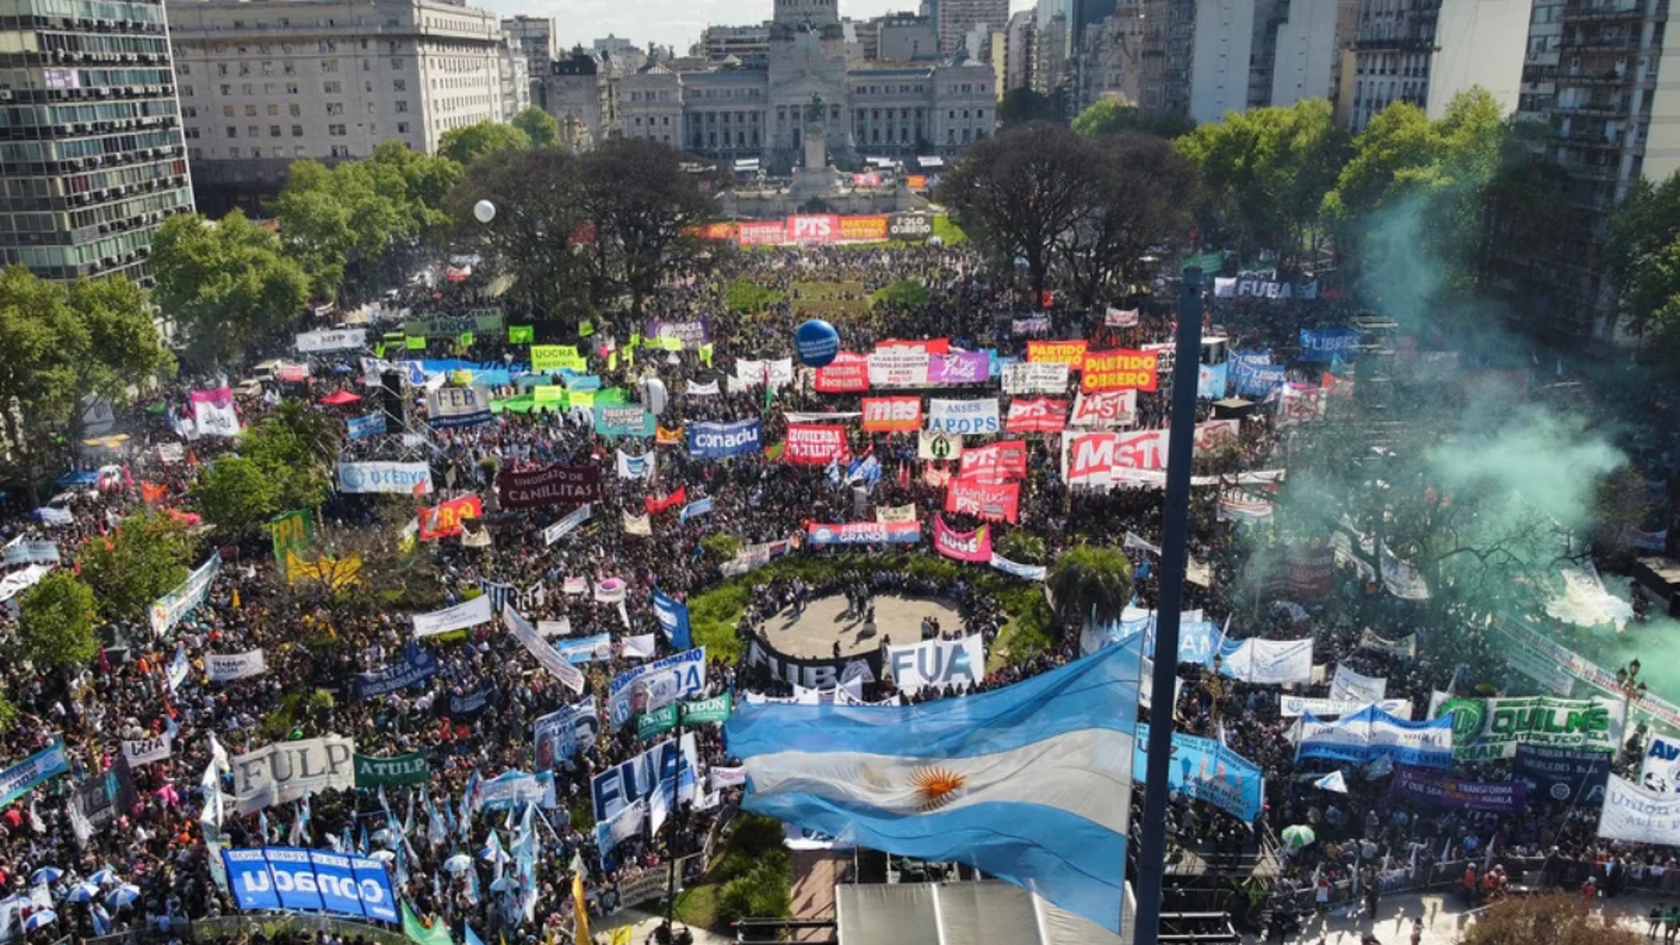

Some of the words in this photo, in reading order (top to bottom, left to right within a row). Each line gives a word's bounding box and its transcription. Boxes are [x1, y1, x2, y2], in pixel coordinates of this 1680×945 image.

[794, 218, 831, 236] PTS
[841, 219, 885, 228] PARTIDO
[1238, 280, 1293, 298] FUBA
[535, 349, 575, 359] UOCRA
[1029, 345, 1086, 357] PARTIDO
[1085, 357, 1155, 371] PARTIDO
[1084, 371, 1150, 387] OBRERO
[438, 390, 475, 407] FEB
[1080, 394, 1127, 419] MST
[865, 401, 920, 421] mas
[1014, 400, 1047, 418] PTS
[931, 416, 997, 434] APOPS
[695, 427, 758, 449] conadu
[962, 446, 999, 470] PTS
[1075, 435, 1166, 472] MST
[514, 470, 567, 487] SINDICATO
[569, 471, 584, 481] DE
[508, 483, 593, 502] CANILLITAS
[956, 497, 980, 515] PTS
[839, 532, 889, 542] GRANDE
[841, 524, 888, 533] FRENTE
[939, 531, 978, 553] AUGE
[652, 648, 703, 670] ROMERO
[747, 641, 876, 688] FUBA
[893, 644, 976, 684] FUA
[239, 743, 350, 793] FULP
[360, 757, 425, 776] ATULP
[1458, 783, 1513, 794] TRANSFORMA
